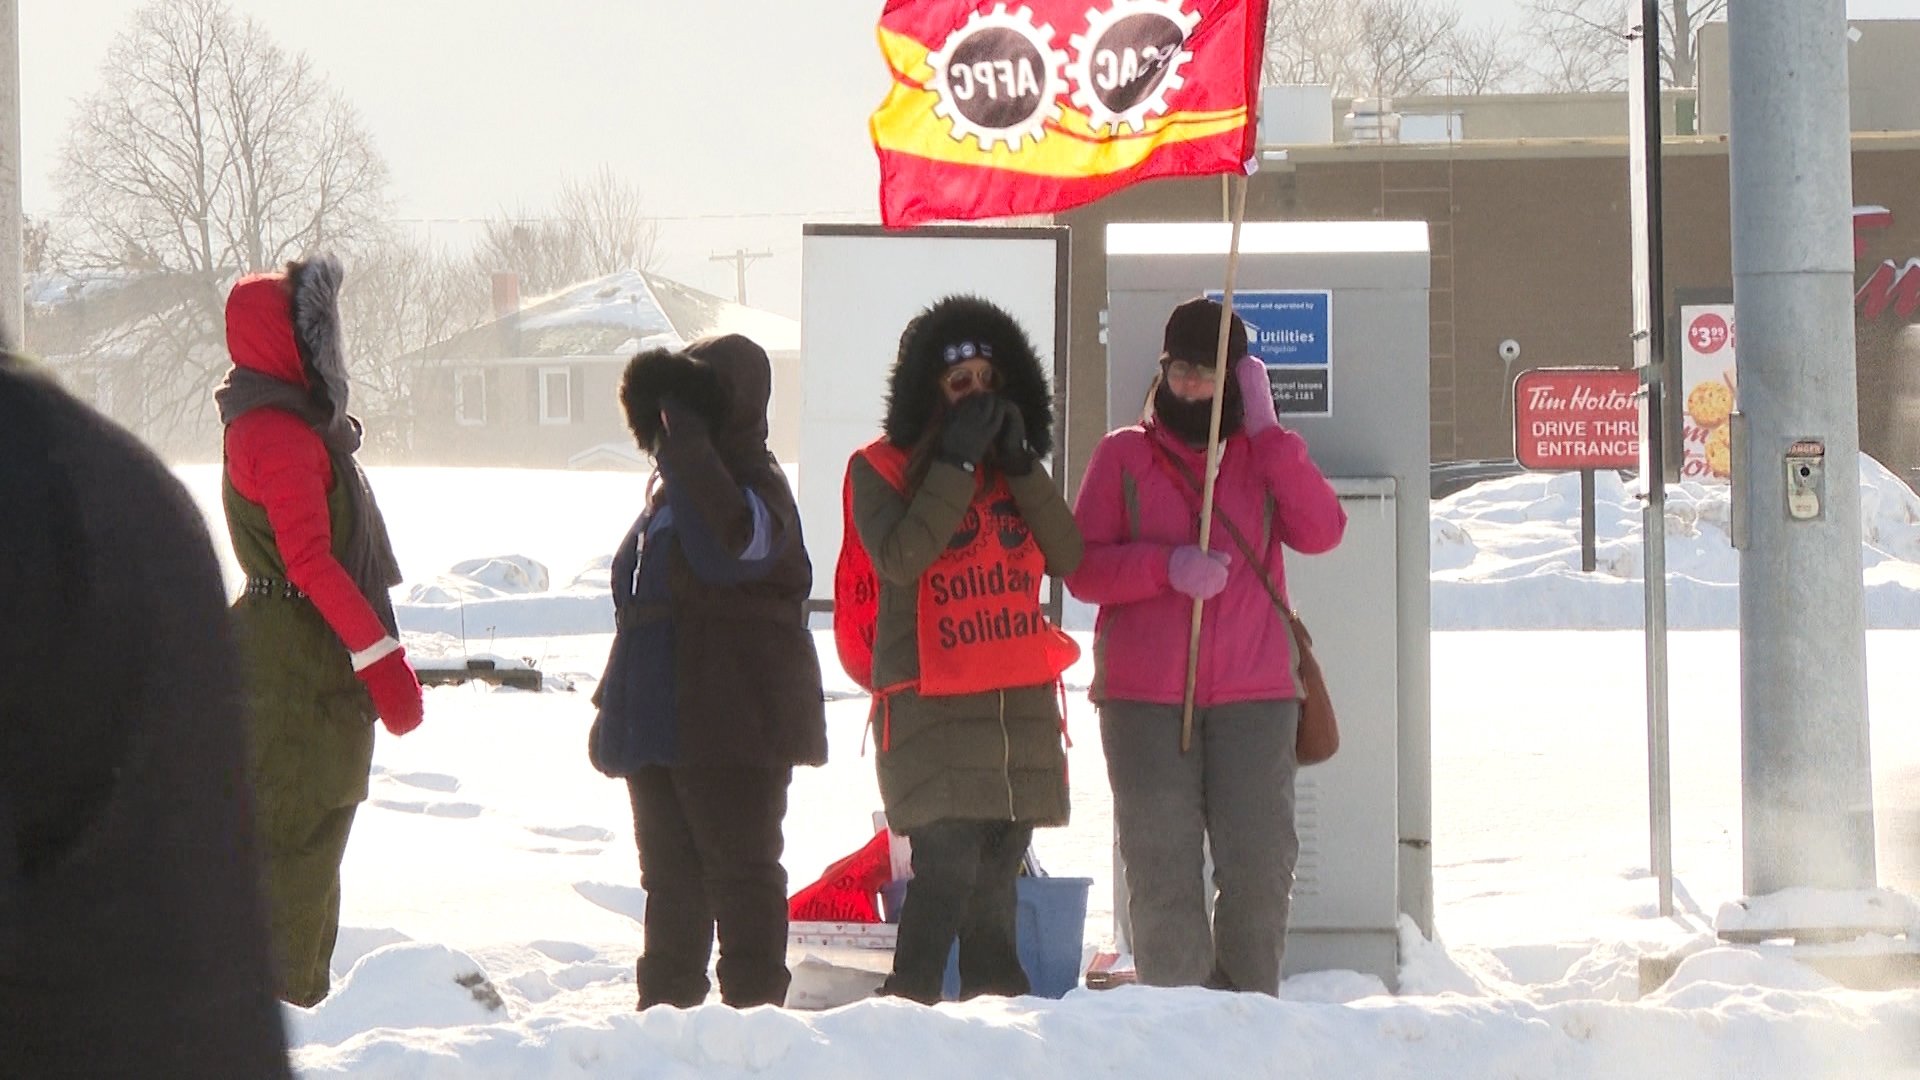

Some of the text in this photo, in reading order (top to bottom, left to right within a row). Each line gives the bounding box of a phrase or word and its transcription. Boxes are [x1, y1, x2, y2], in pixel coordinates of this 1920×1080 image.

[1260, 302, 1273, 310] and
[1261, 330, 1315, 343] Utilities
[1527, 385, 1640, 411] Tim Horton
[1531, 421, 1588, 437] DRIVE
[1536, 441, 1641, 457] ENTRANCE
